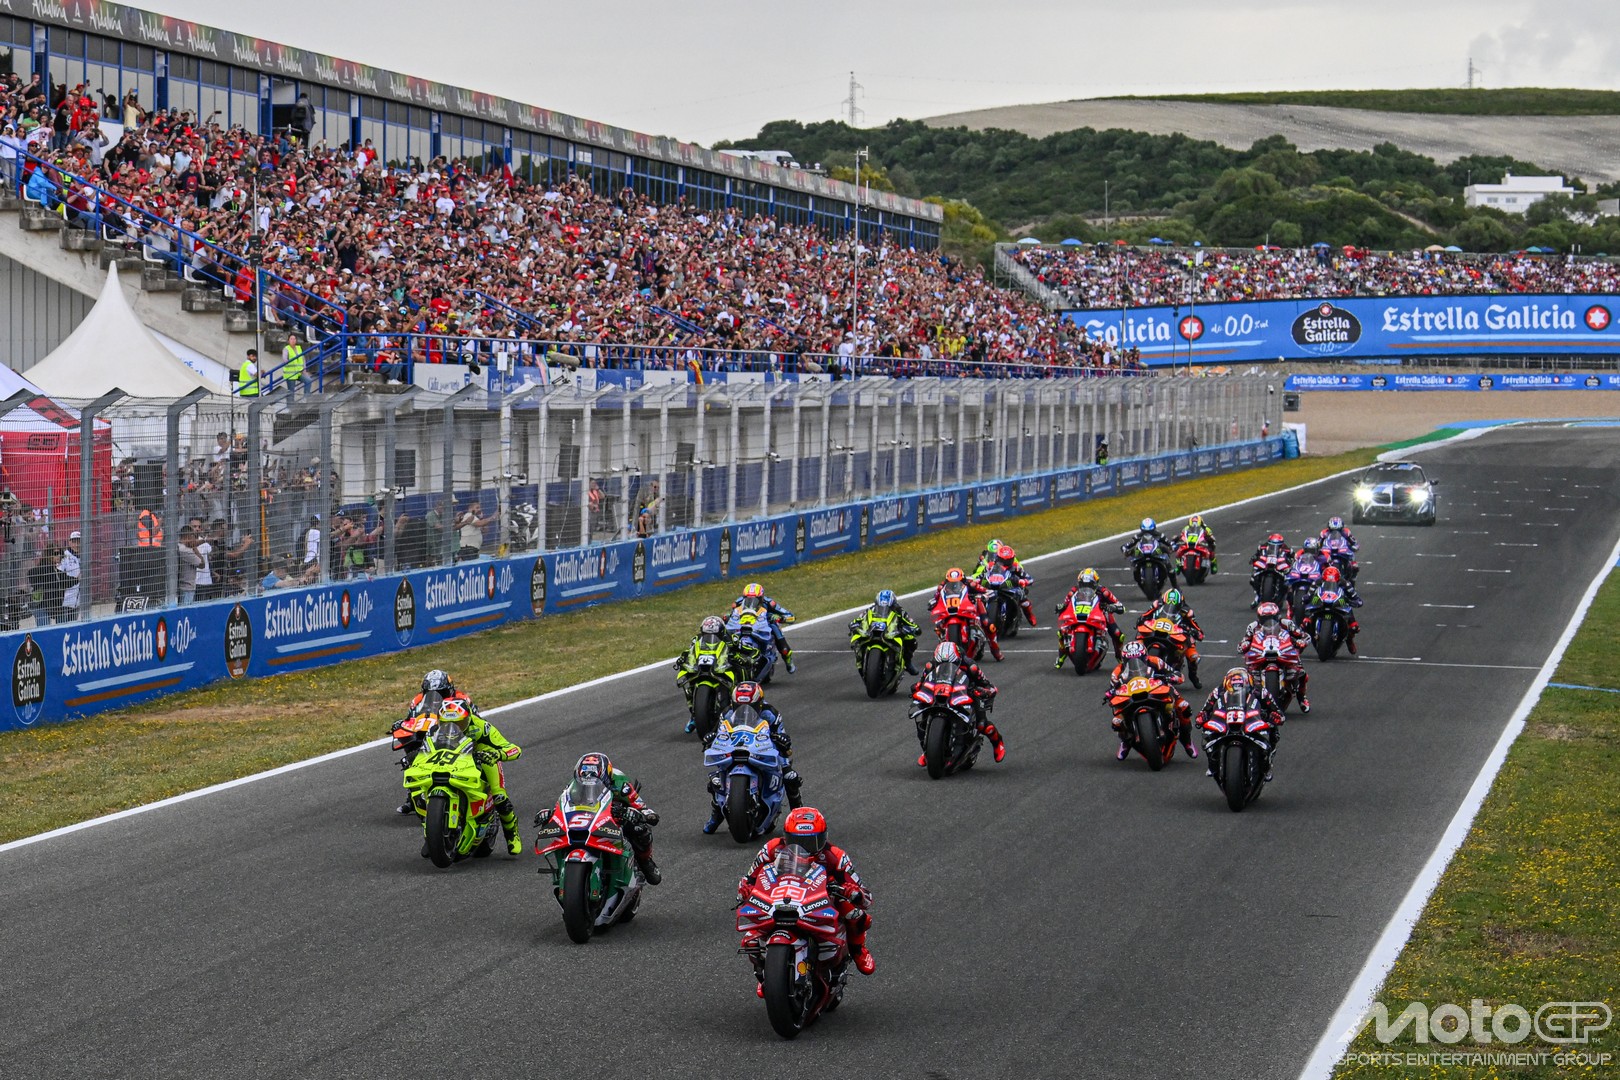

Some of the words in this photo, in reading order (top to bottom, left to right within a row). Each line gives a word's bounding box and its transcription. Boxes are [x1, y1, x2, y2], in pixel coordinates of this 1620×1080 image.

[1303, 317, 1350, 329] Estrella
[1382, 306, 1479, 332] Estrella
[1485, 304, 1576, 330] Galicia
[1305, 329, 1348, 342] Galicia
[554, 553, 578, 586] Estrella
[425, 574, 457, 610] Estrella
[457, 565, 486, 603] Galicia
[946, 598, 960, 607] 10
[1075, 605, 1092, 614] 36
[264, 598, 304, 639] Estrella
[304, 591, 338, 633] Galicia
[229, 621, 248, 640] Estrella
[61, 630, 110, 677] Estrella
[111, 619, 154, 667] Galicia
[17, 657, 41, 680] Estrella
[18, 679, 40, 701] Galicia
[1130, 680, 1147, 692] 23
[415, 718, 437, 729] 37
[426, 751, 460, 765] 49
[568, 813, 593, 828] 5
[749, 896, 770, 910] Lenovo
[803, 899, 828, 912] Lenovo
